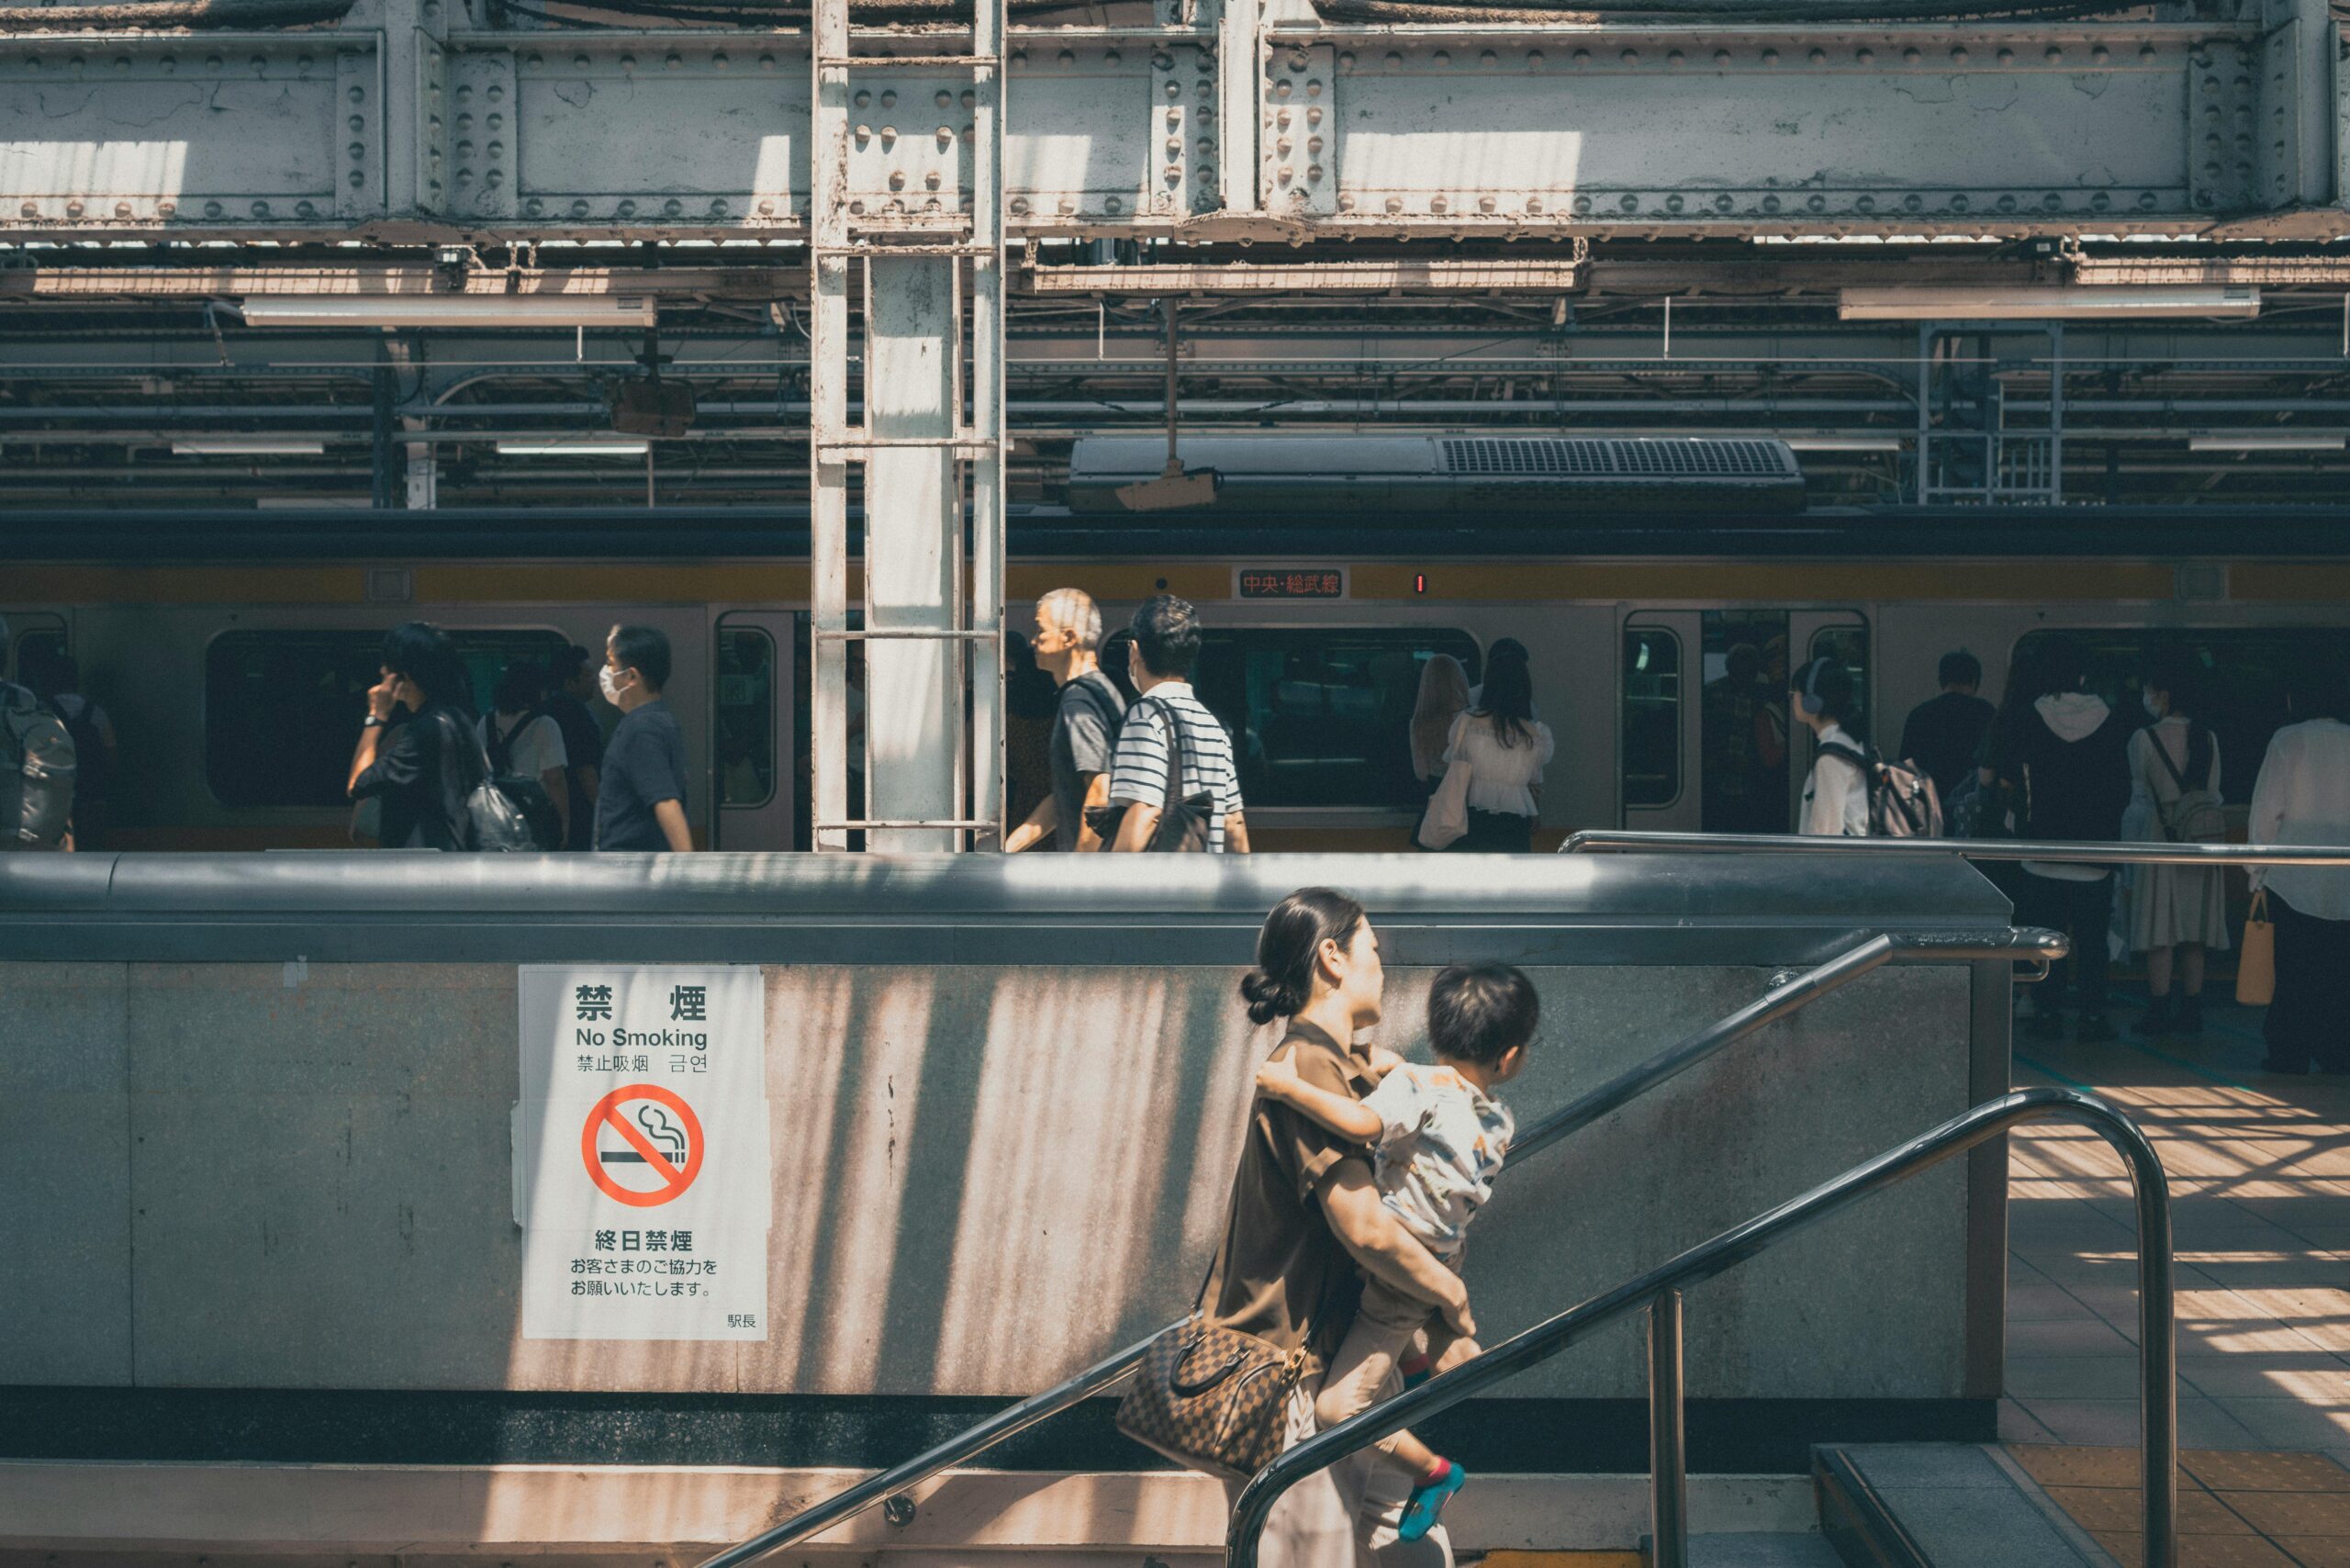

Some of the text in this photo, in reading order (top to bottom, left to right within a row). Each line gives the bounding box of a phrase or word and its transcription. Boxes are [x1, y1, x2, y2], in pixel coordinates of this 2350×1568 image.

[1244, 574, 1338, 593] 中央・総武線
[576, 1027, 708, 1050] No Smoking
[576, 1054, 708, 1073] 禁止吸烟 금연
[594, 1230, 693, 1252] 終日禁煙
[570, 1259, 718, 1276] お客さまのご協力を
[570, 1281, 710, 1297] お願いいたします。
[727, 1314, 756, 1328] 駅長
